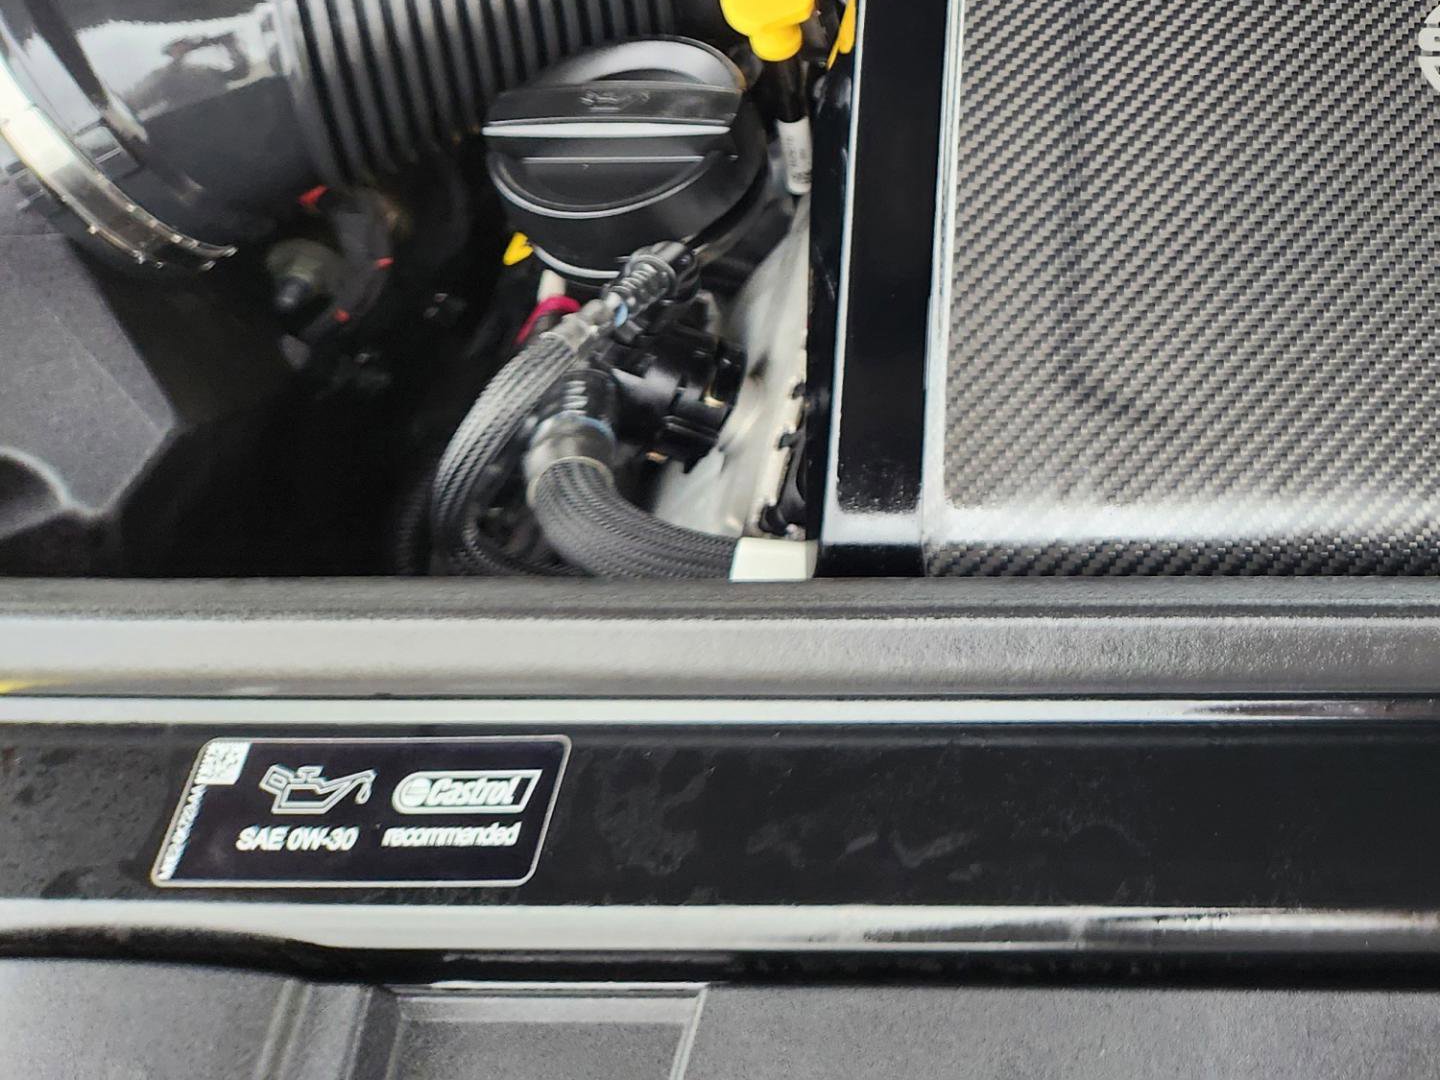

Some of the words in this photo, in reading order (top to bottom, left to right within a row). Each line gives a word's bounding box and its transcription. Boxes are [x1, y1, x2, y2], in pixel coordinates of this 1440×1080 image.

[424, 776, 522, 806] Castrol
[235, 825, 290, 851] SAE
[286, 826, 360, 851] 0W-30
[381, 821, 523, 848] recommended
